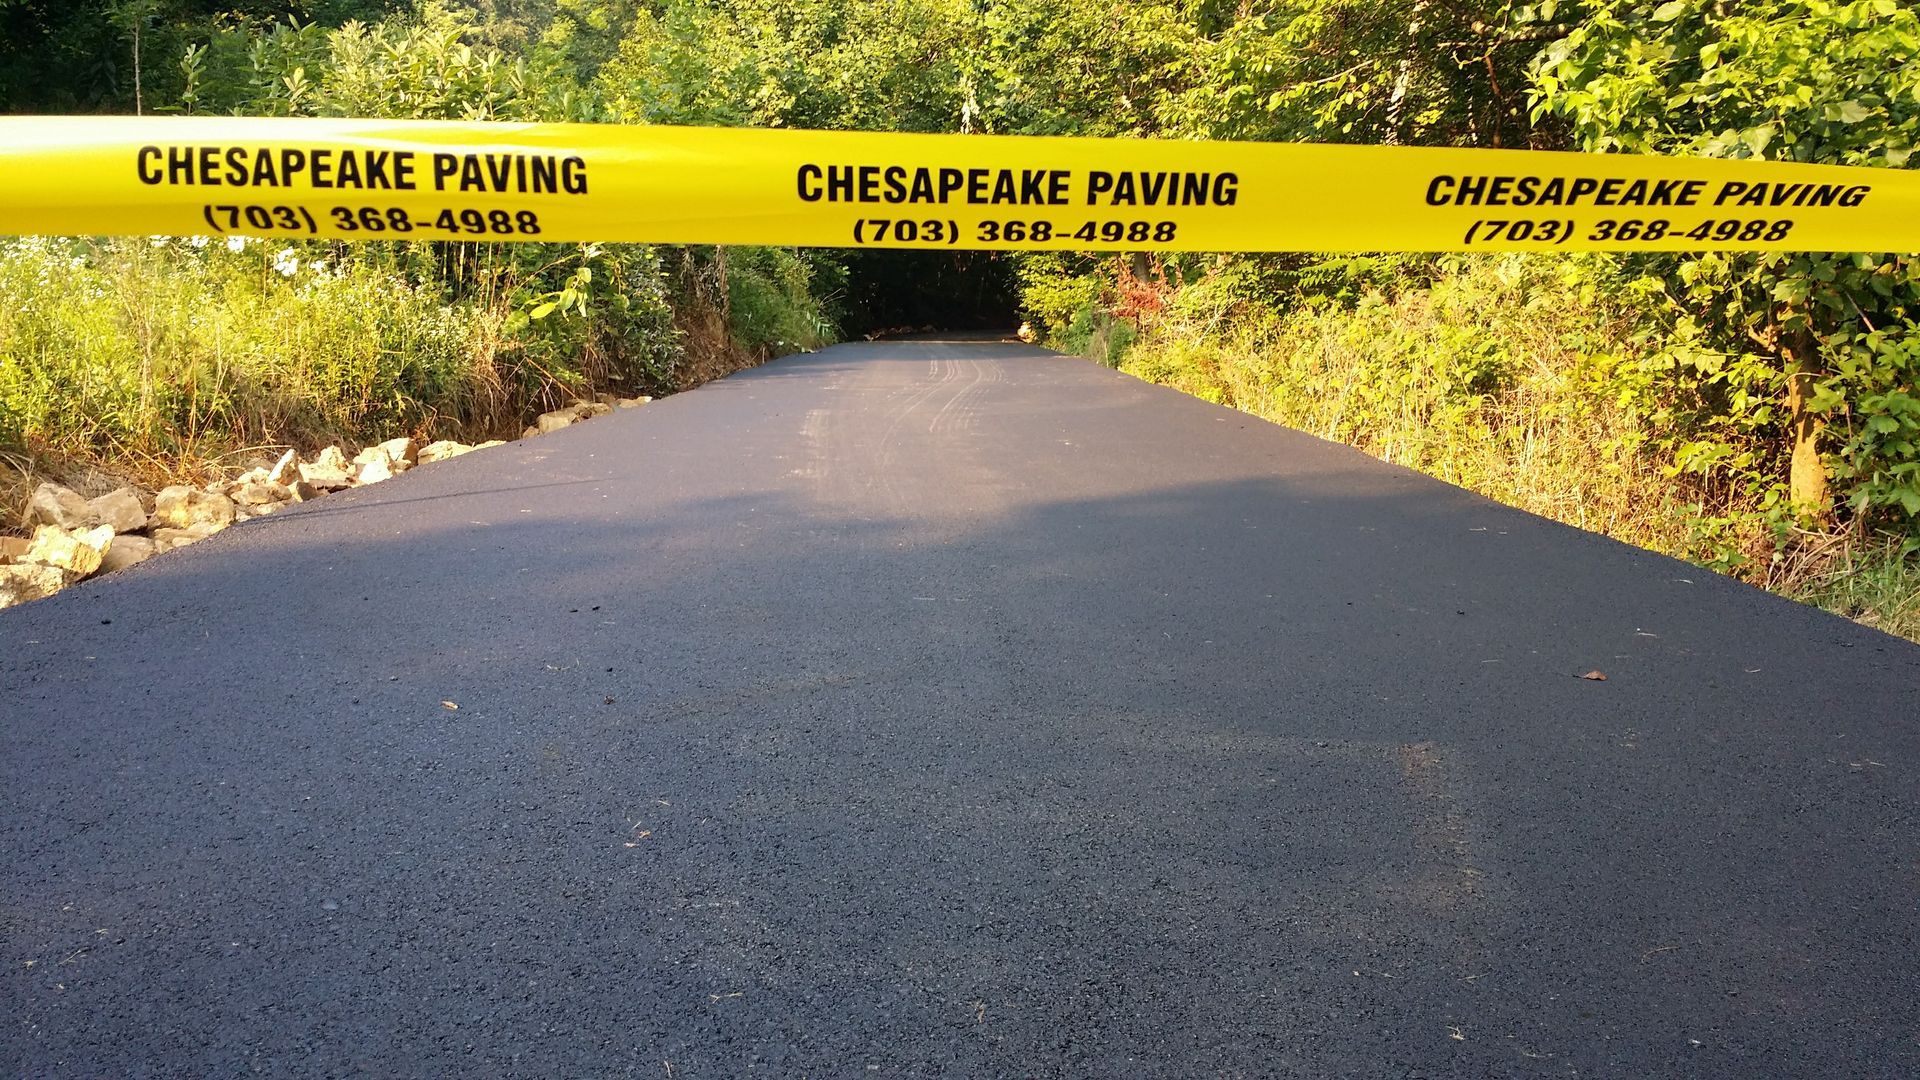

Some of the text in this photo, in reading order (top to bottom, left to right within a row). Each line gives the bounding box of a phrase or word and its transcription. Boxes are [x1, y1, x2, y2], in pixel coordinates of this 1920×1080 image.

[137, 146, 588, 195] CHESAPEAKE PAVING
[797, 163, 1239, 207] CHESAPEAKE PAVING
[1425, 174, 1872, 208] CHESAPEAKE PAVING
[203, 204, 541, 236] (703) 368-4988
[853, 218, 1177, 245] (703) 368-4988
[1464, 219, 1794, 245] (703) 368-4988
